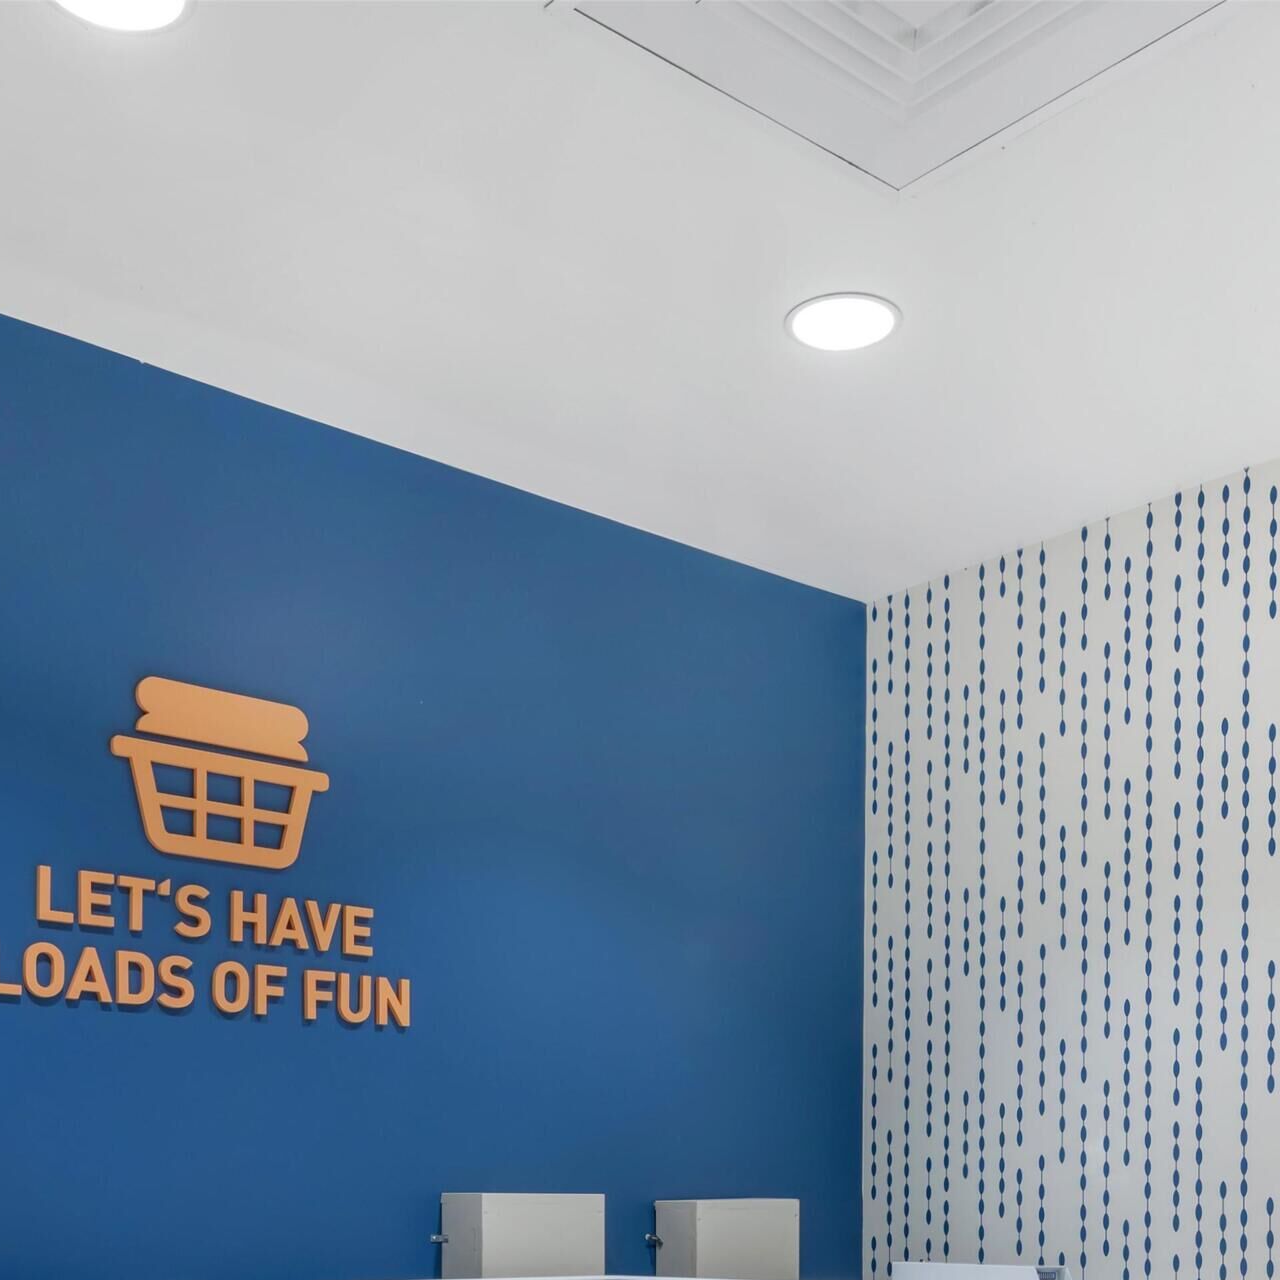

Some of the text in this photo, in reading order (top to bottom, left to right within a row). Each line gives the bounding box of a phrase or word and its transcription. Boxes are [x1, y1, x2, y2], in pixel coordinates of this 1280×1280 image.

[36, 865, 374, 957] LET'S HAVE
[212, 961, 287, 1016] OF
[303, 969, 410, 1027] FUN
